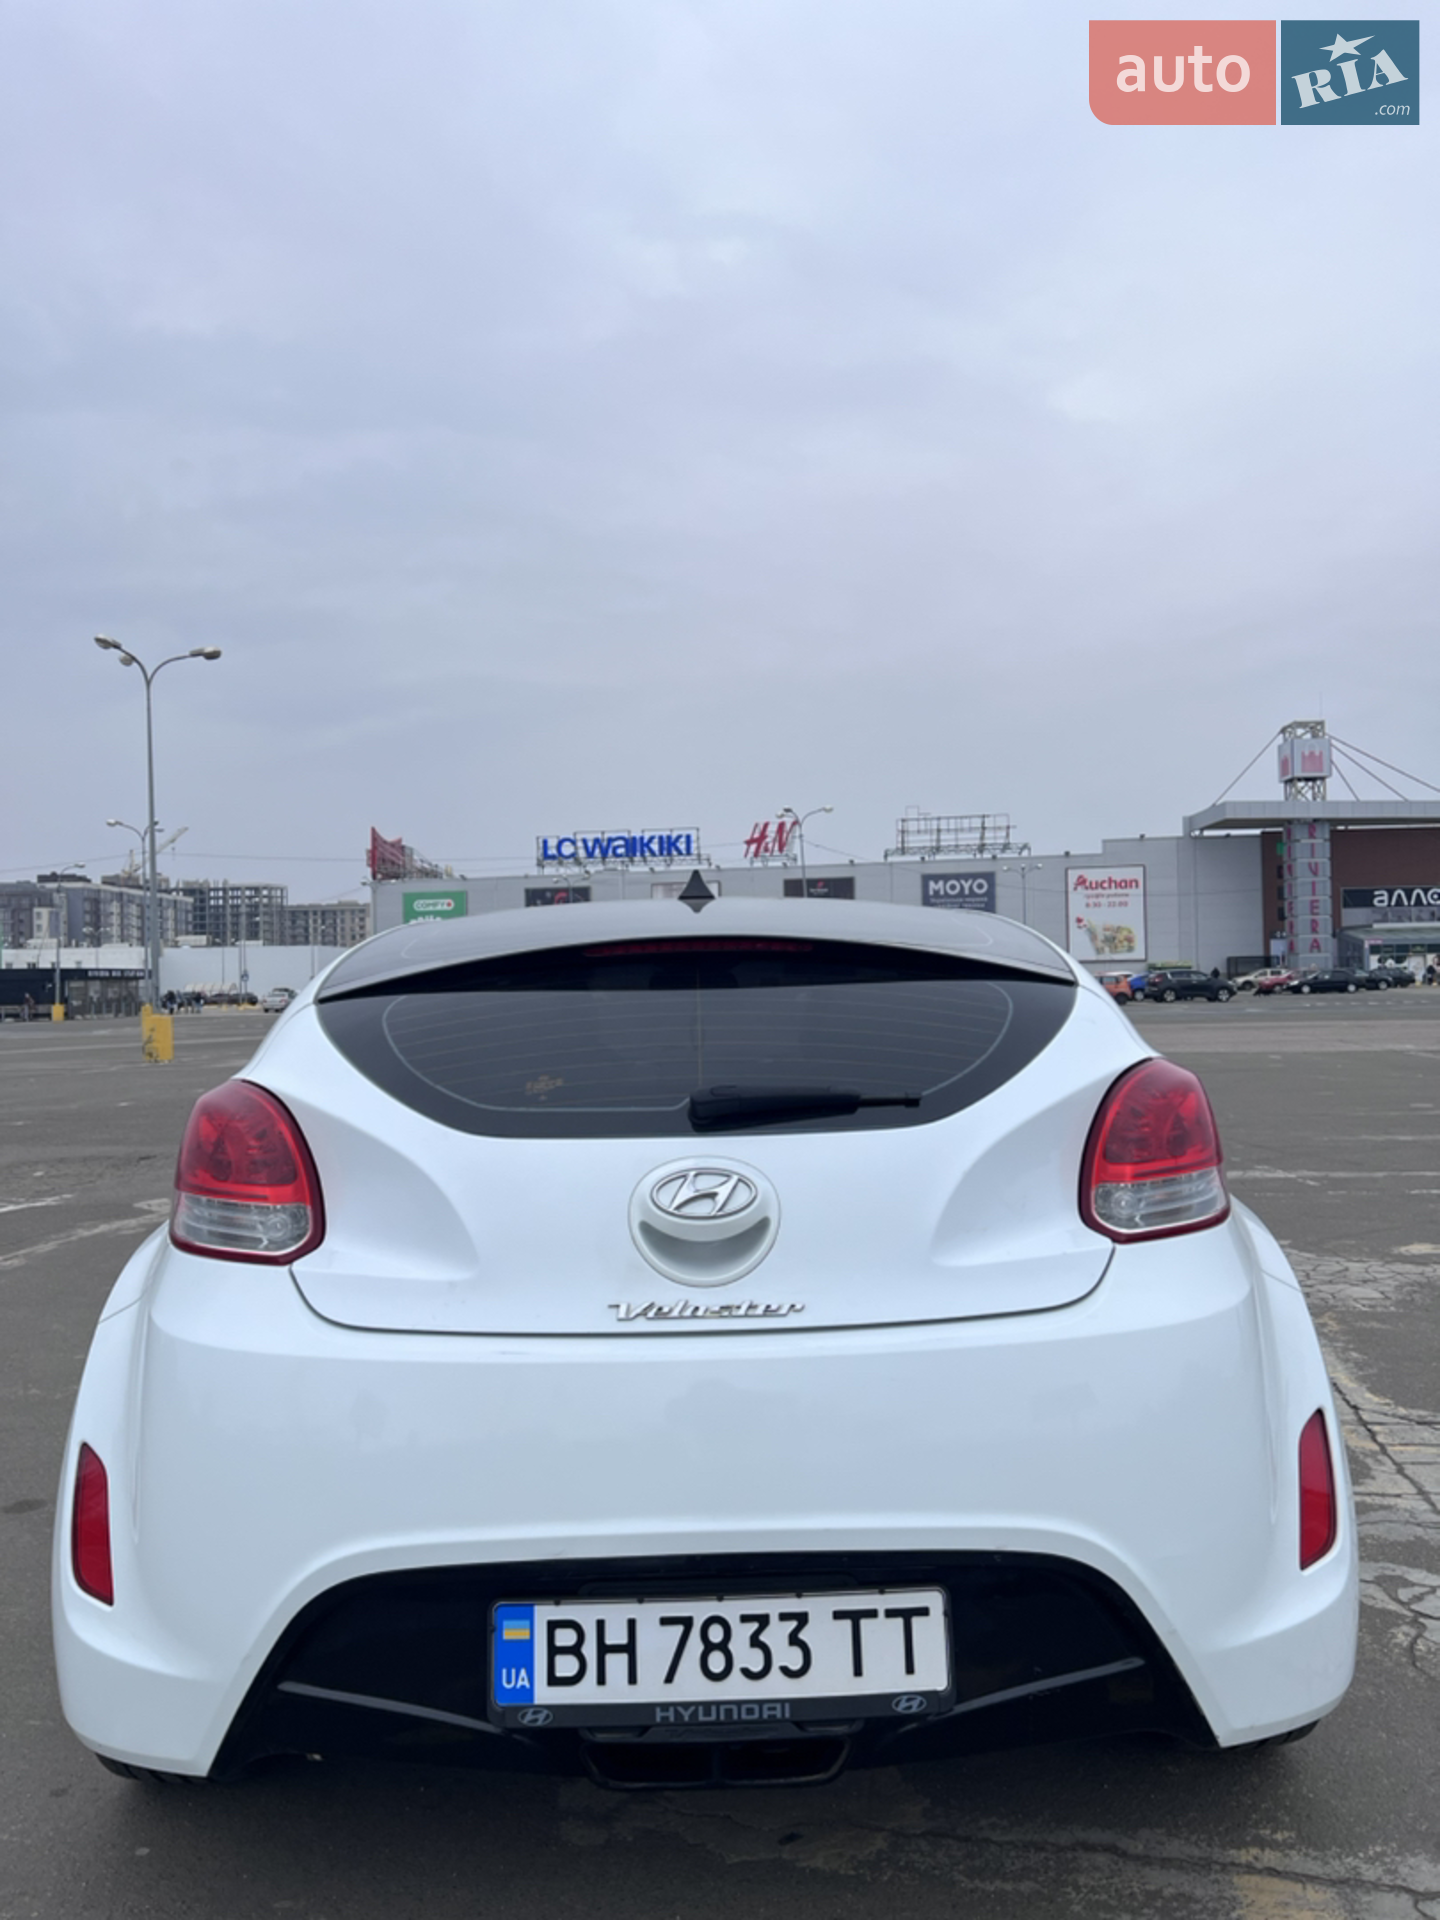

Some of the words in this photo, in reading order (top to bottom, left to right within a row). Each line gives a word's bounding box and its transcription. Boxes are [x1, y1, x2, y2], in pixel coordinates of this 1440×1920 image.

[542, 837, 577, 861] LC
[929, 878, 988, 896] MOYO
[1073, 875, 1139, 891] Auchan
[1308, 823, 1321, 953] RIVIERA
[608, 1298, 805, 1321] Veloster
[502, 1668, 530, 1690] UA
[546, 1618, 638, 1688] BH
[658, 1610, 813, 1684] 7833
[832, 1606, 931, 1678] TT
[655, 1702, 791, 1723] HYUNDAI
